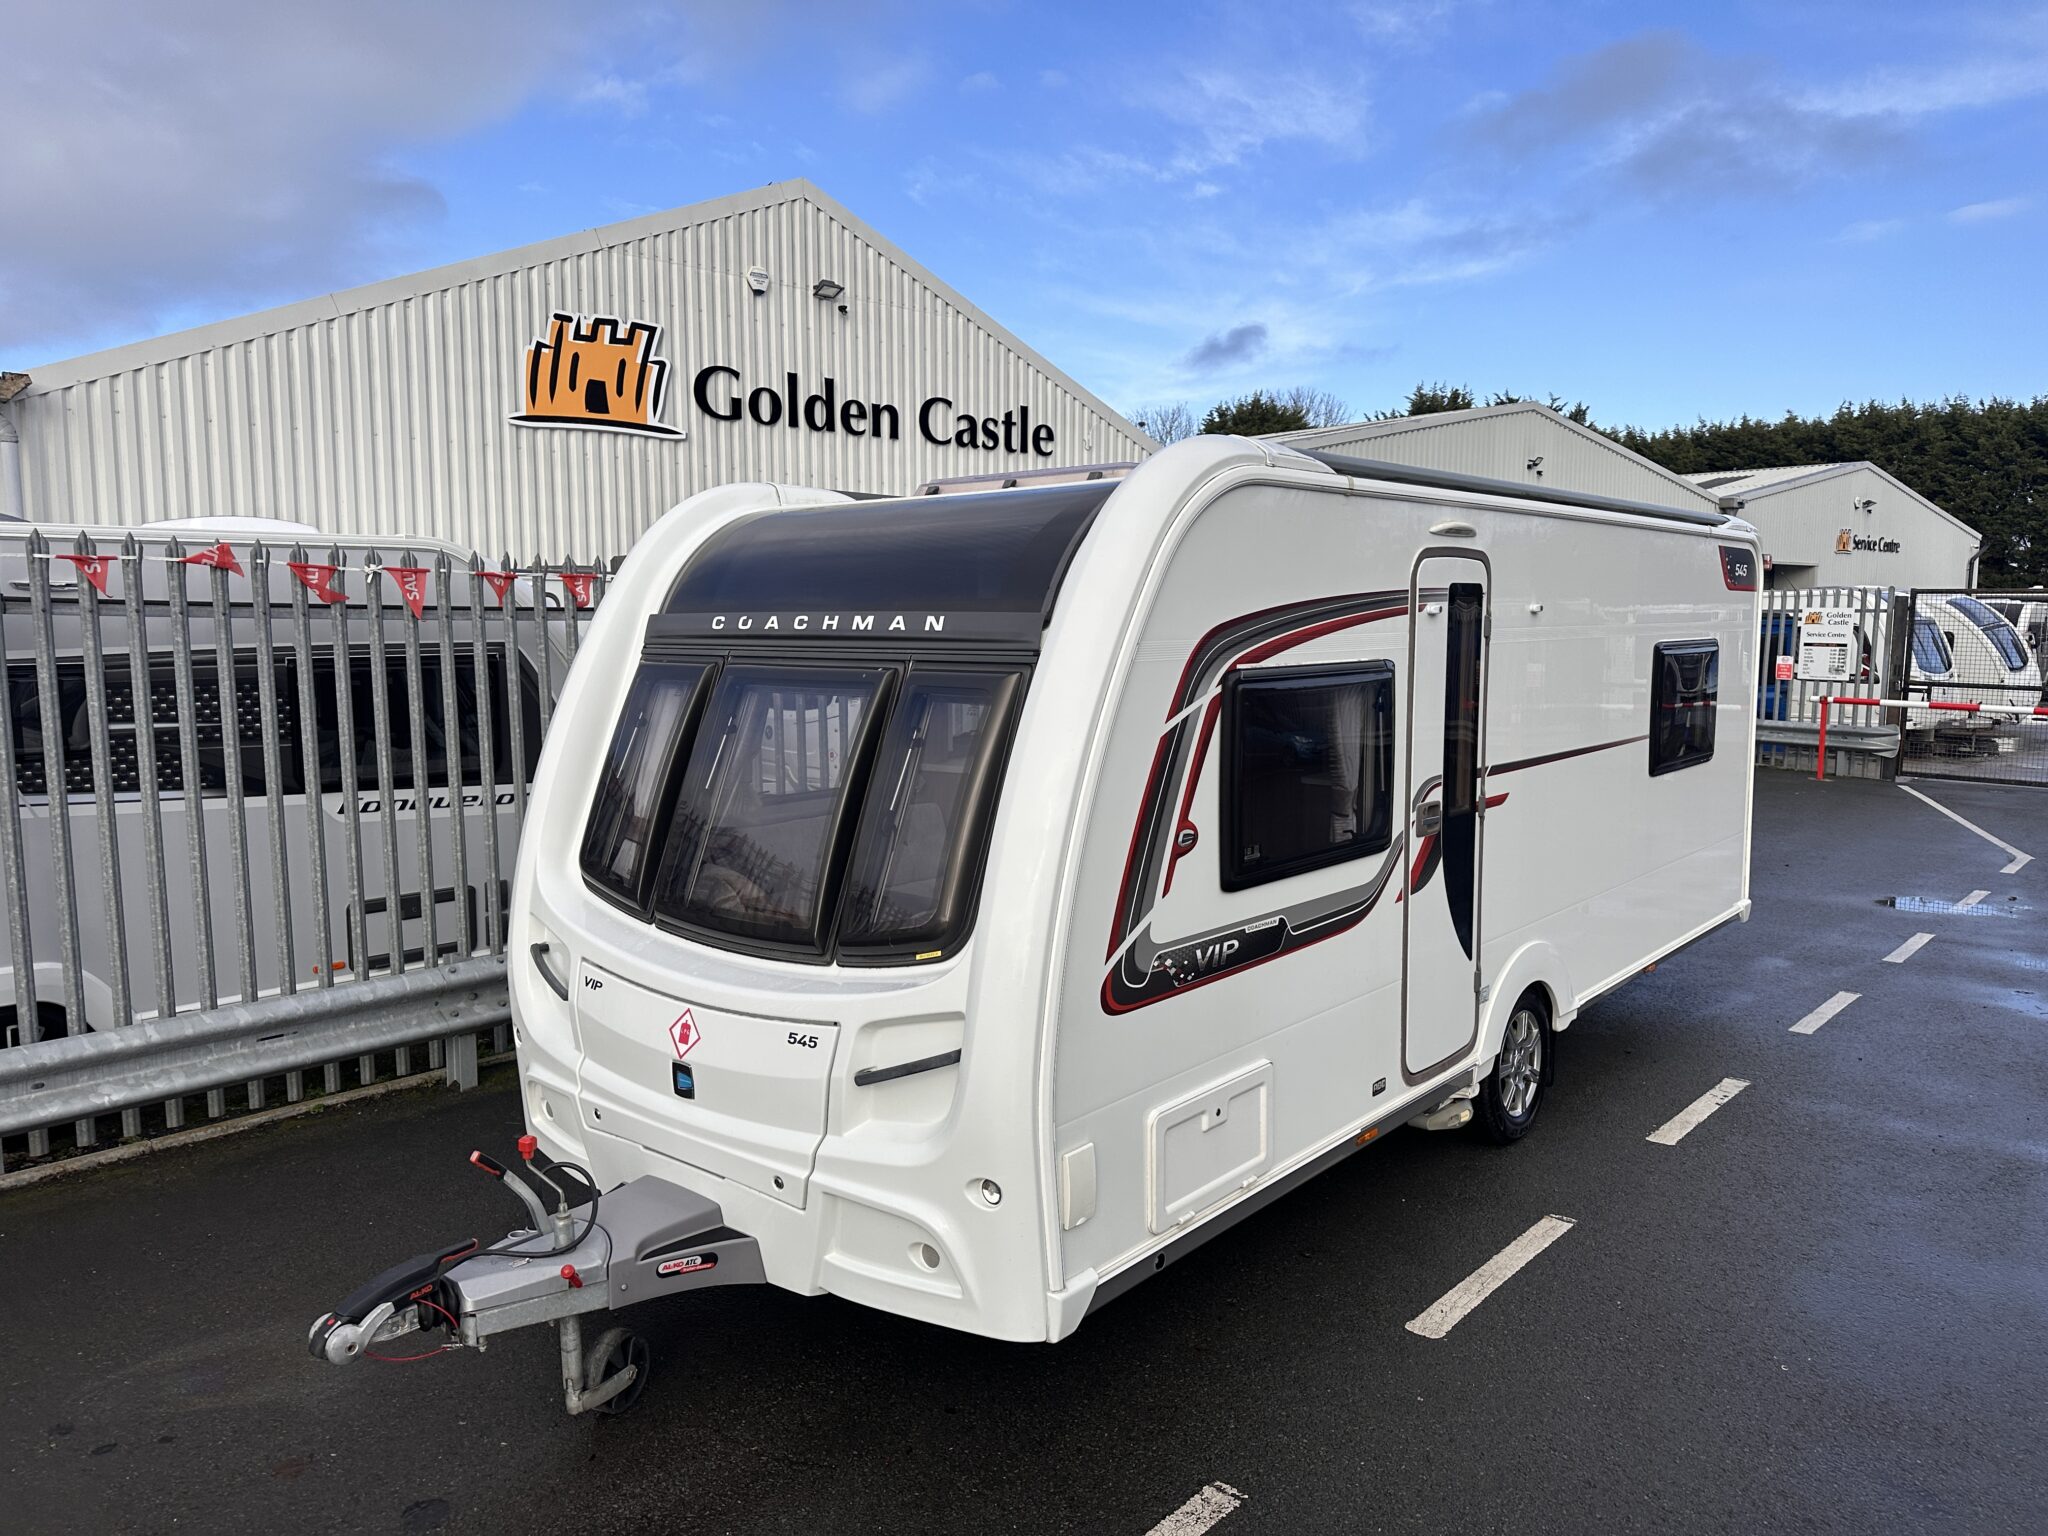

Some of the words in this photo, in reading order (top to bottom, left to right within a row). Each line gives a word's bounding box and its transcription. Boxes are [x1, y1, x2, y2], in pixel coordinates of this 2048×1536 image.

[693, 365, 899, 440] Golden
[919, 397, 1055, 457] Castle
[1853, 534, 1877, 552] Service
[1878, 537, 1901, 553] Centre
[1735, 563, 1748, 577] 545
[711, 615, 945, 632] COACHMAN
[1826, 611, 1852, 619] Golden
[1247, 919, 1277, 931] COACHMAN
[1195, 939, 1239, 971] VIP
[585, 975, 603, 990] VIP
[787, 1031, 819, 1049] 545
